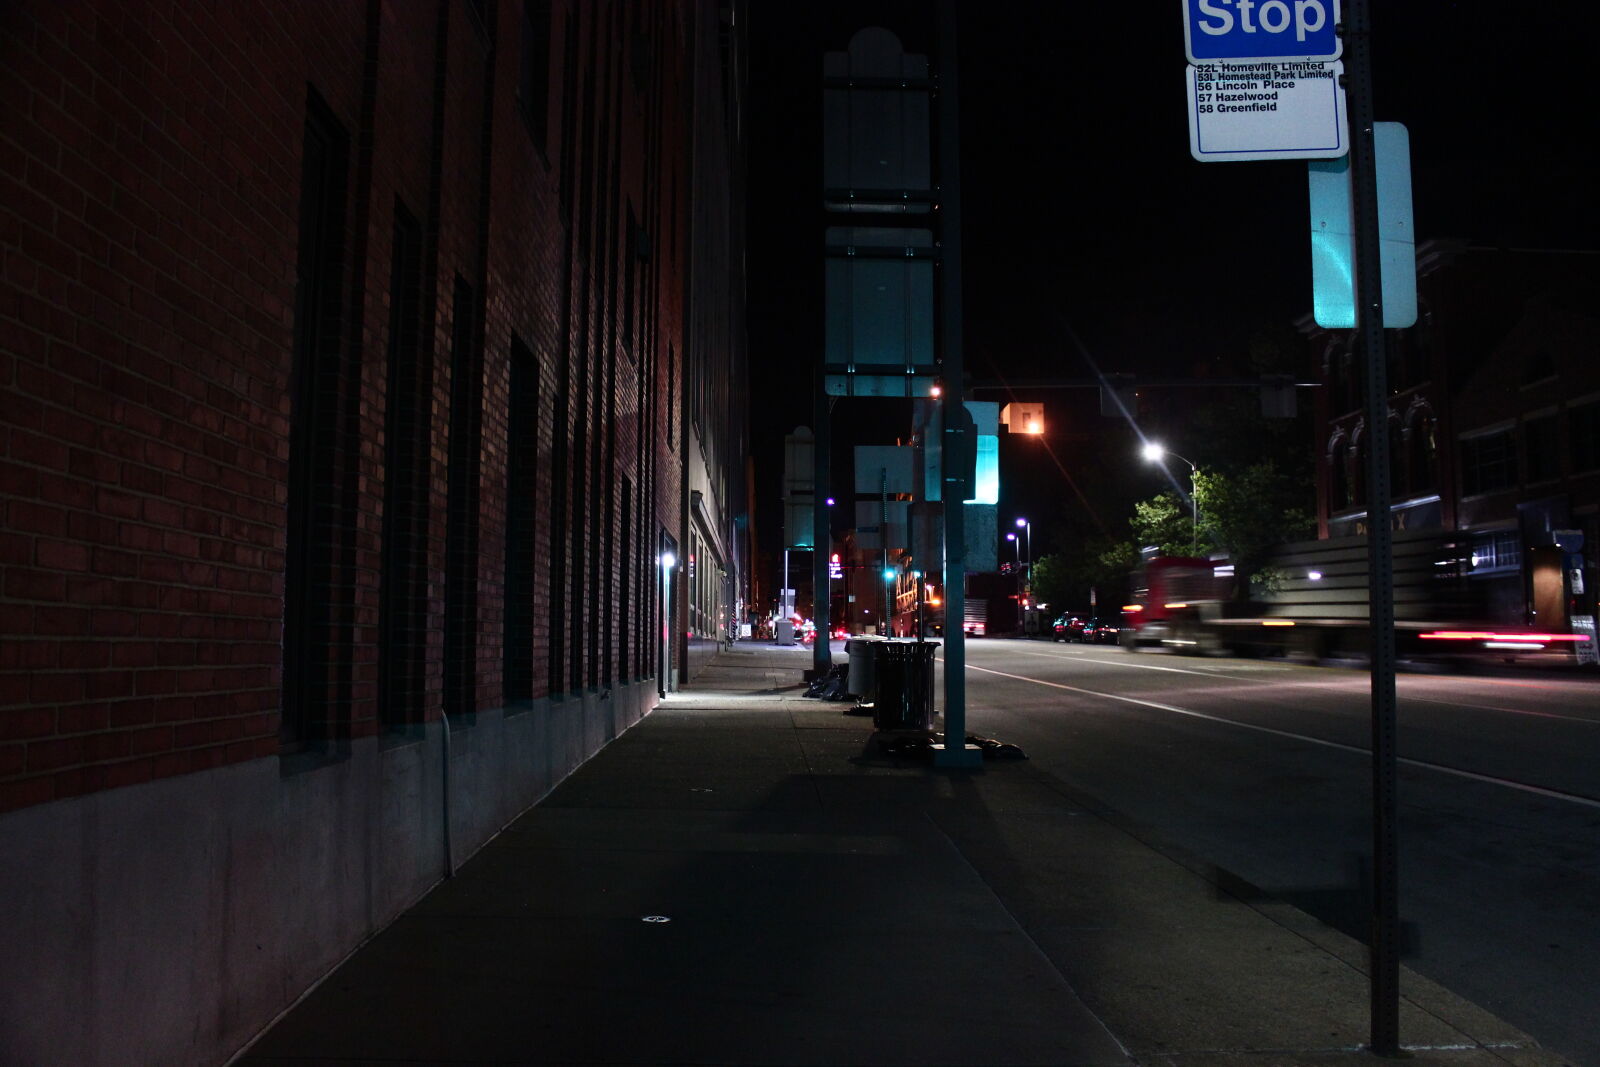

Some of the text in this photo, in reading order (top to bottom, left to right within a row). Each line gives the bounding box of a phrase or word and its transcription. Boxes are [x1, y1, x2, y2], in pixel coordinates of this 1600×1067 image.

[1197, 0, 1326, 41] Stop
[1197, 62, 1324, 72] 52L Homeville Limited
[1198, 70, 1334, 81] 53L Homestead Park Limited
[1198, 80, 1295, 91] 56 Lincoln Place
[1198, 92, 1278, 102] 57 Hazelwood
[1199, 102, 1277, 113] 58 Greenfield
